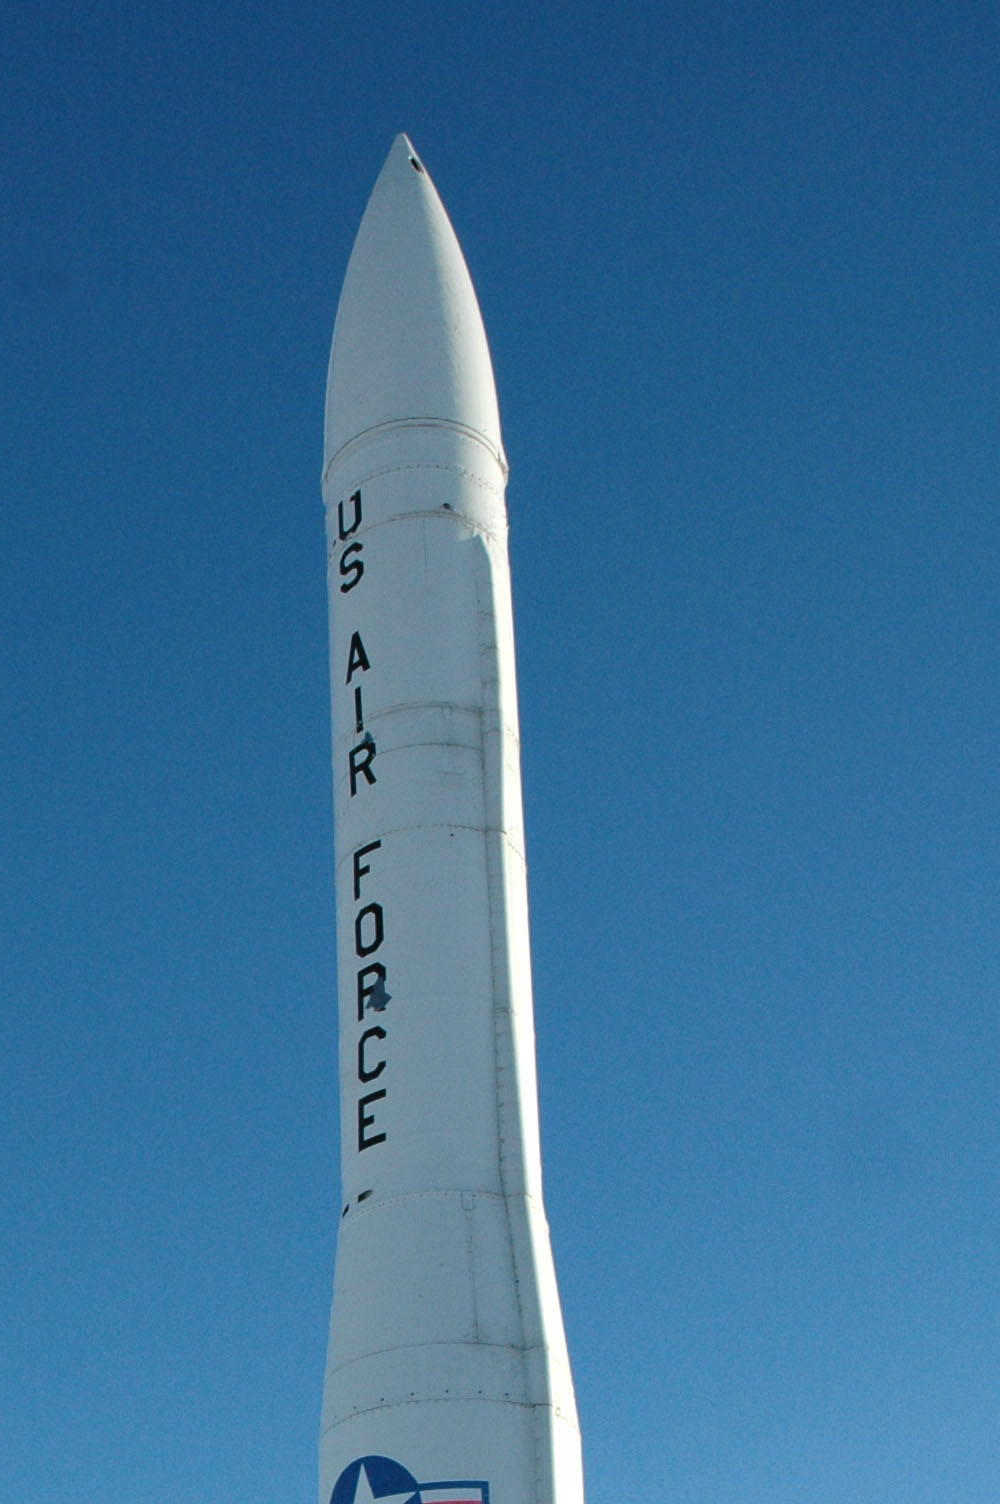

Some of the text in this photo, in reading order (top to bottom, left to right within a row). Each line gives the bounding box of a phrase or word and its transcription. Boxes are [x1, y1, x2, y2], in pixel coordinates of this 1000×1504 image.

[337, 489, 387, 1153] US AIR FORCE
